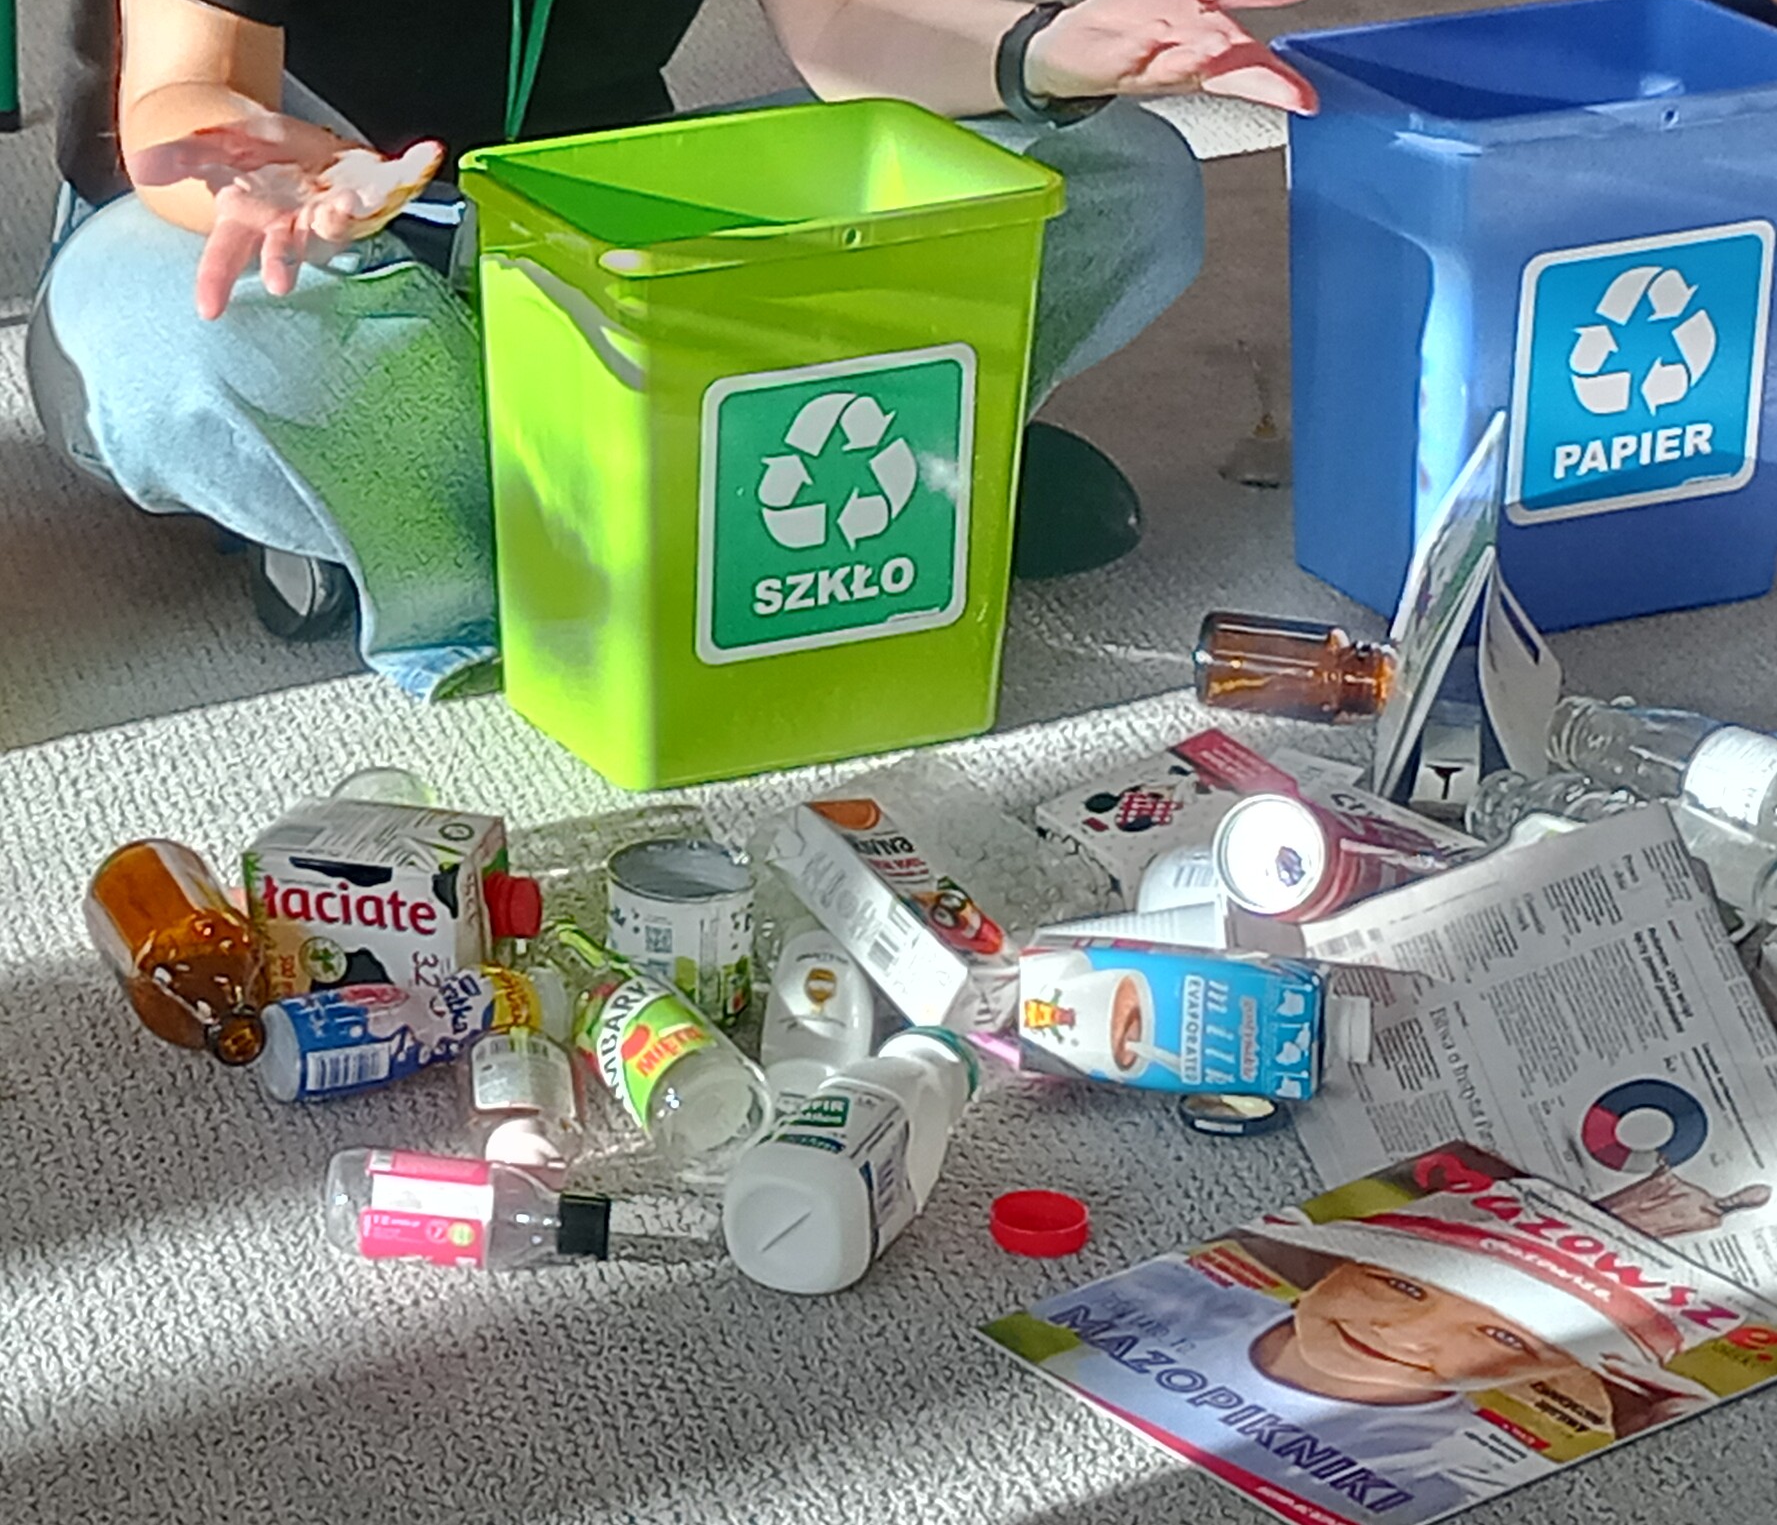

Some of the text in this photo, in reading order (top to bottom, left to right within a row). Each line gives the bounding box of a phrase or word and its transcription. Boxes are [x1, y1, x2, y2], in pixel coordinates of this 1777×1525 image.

[1553, 422, 1714, 480] PAPIER
[752, 556, 916, 616] SZKŁO
[262, 874, 438, 936] łaciate
[1184, 978, 1203, 1083] EVAPORATED
[1048, 1302, 1415, 1514] MAZOPIKNIKI
